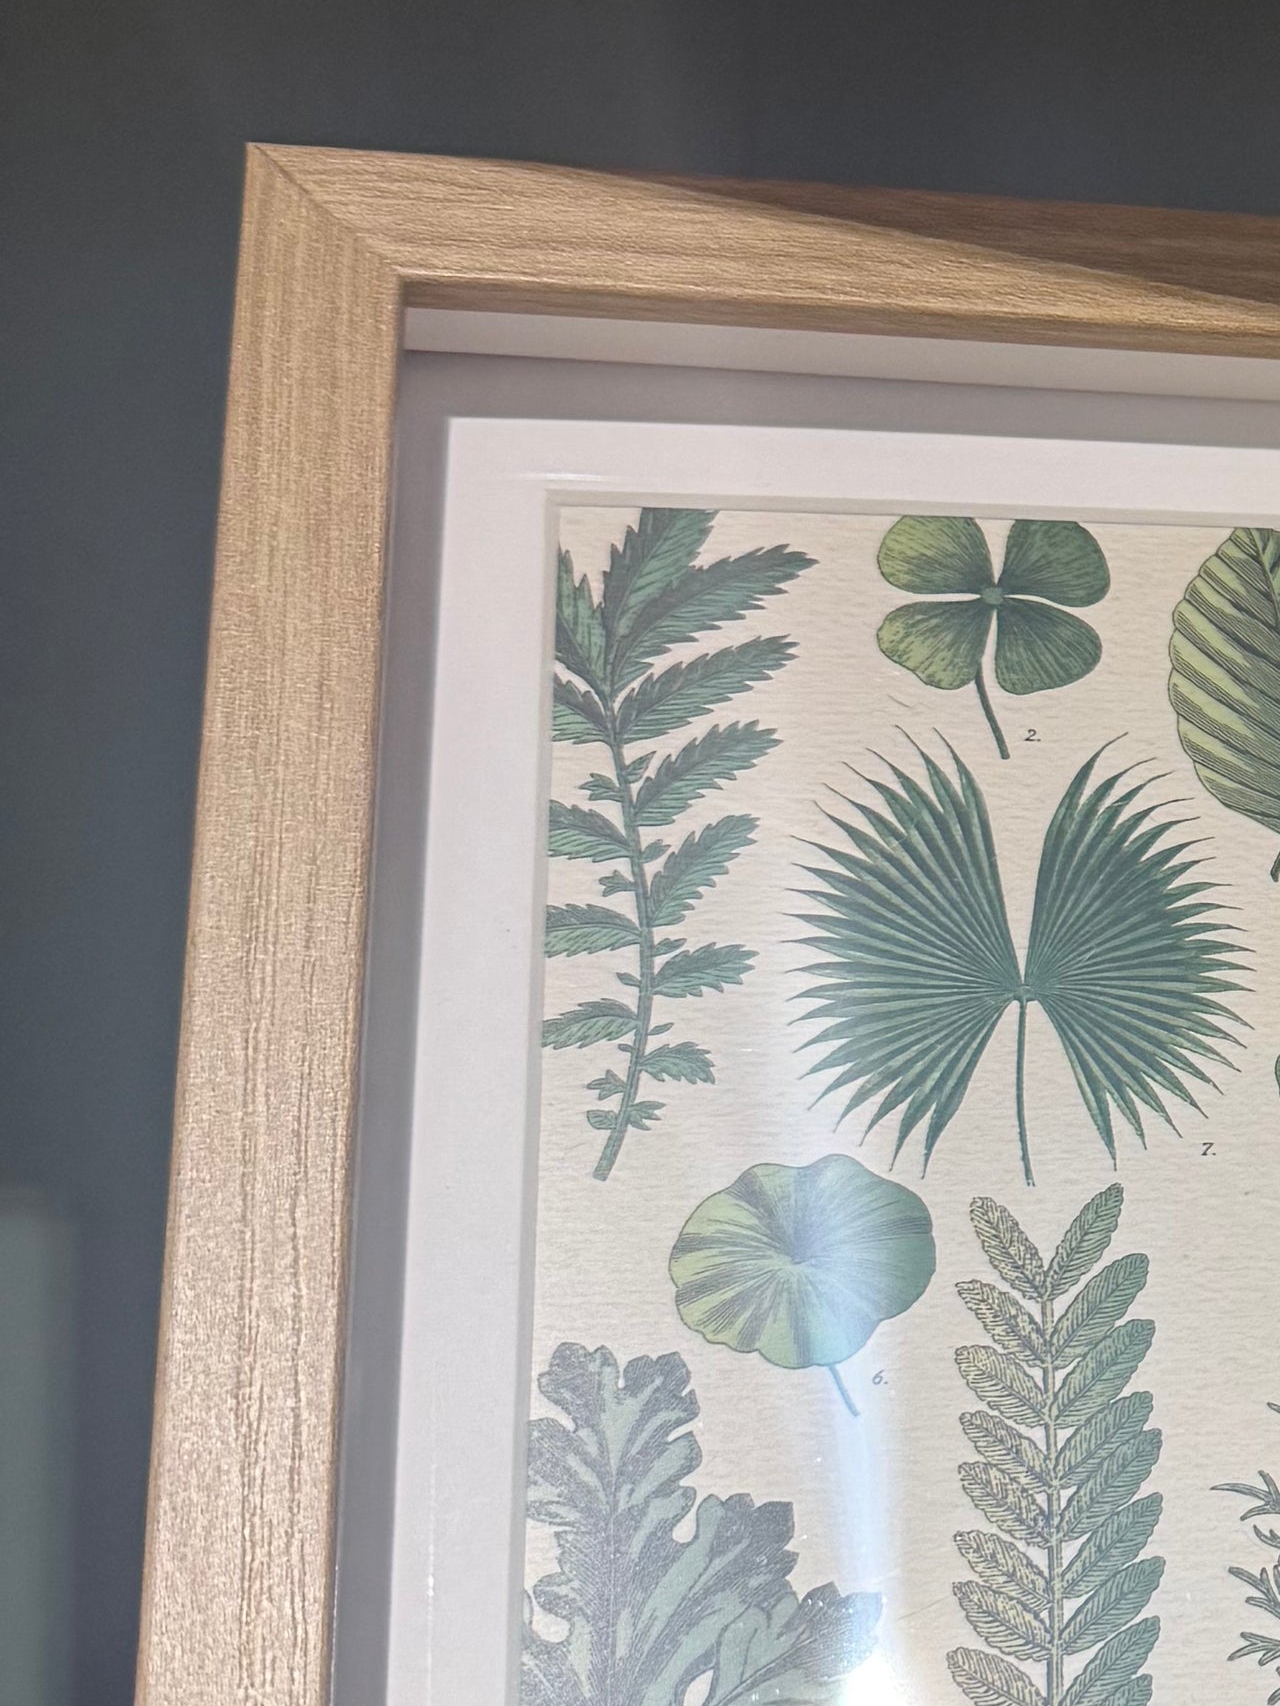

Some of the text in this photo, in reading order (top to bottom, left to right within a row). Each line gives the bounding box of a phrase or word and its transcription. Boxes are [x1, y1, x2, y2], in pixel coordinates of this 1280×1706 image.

[1023, 728, 1042, 742] 2.
[1200, 1141, 1217, 1156] 7.
[871, 1369, 889, 1385] 6.
